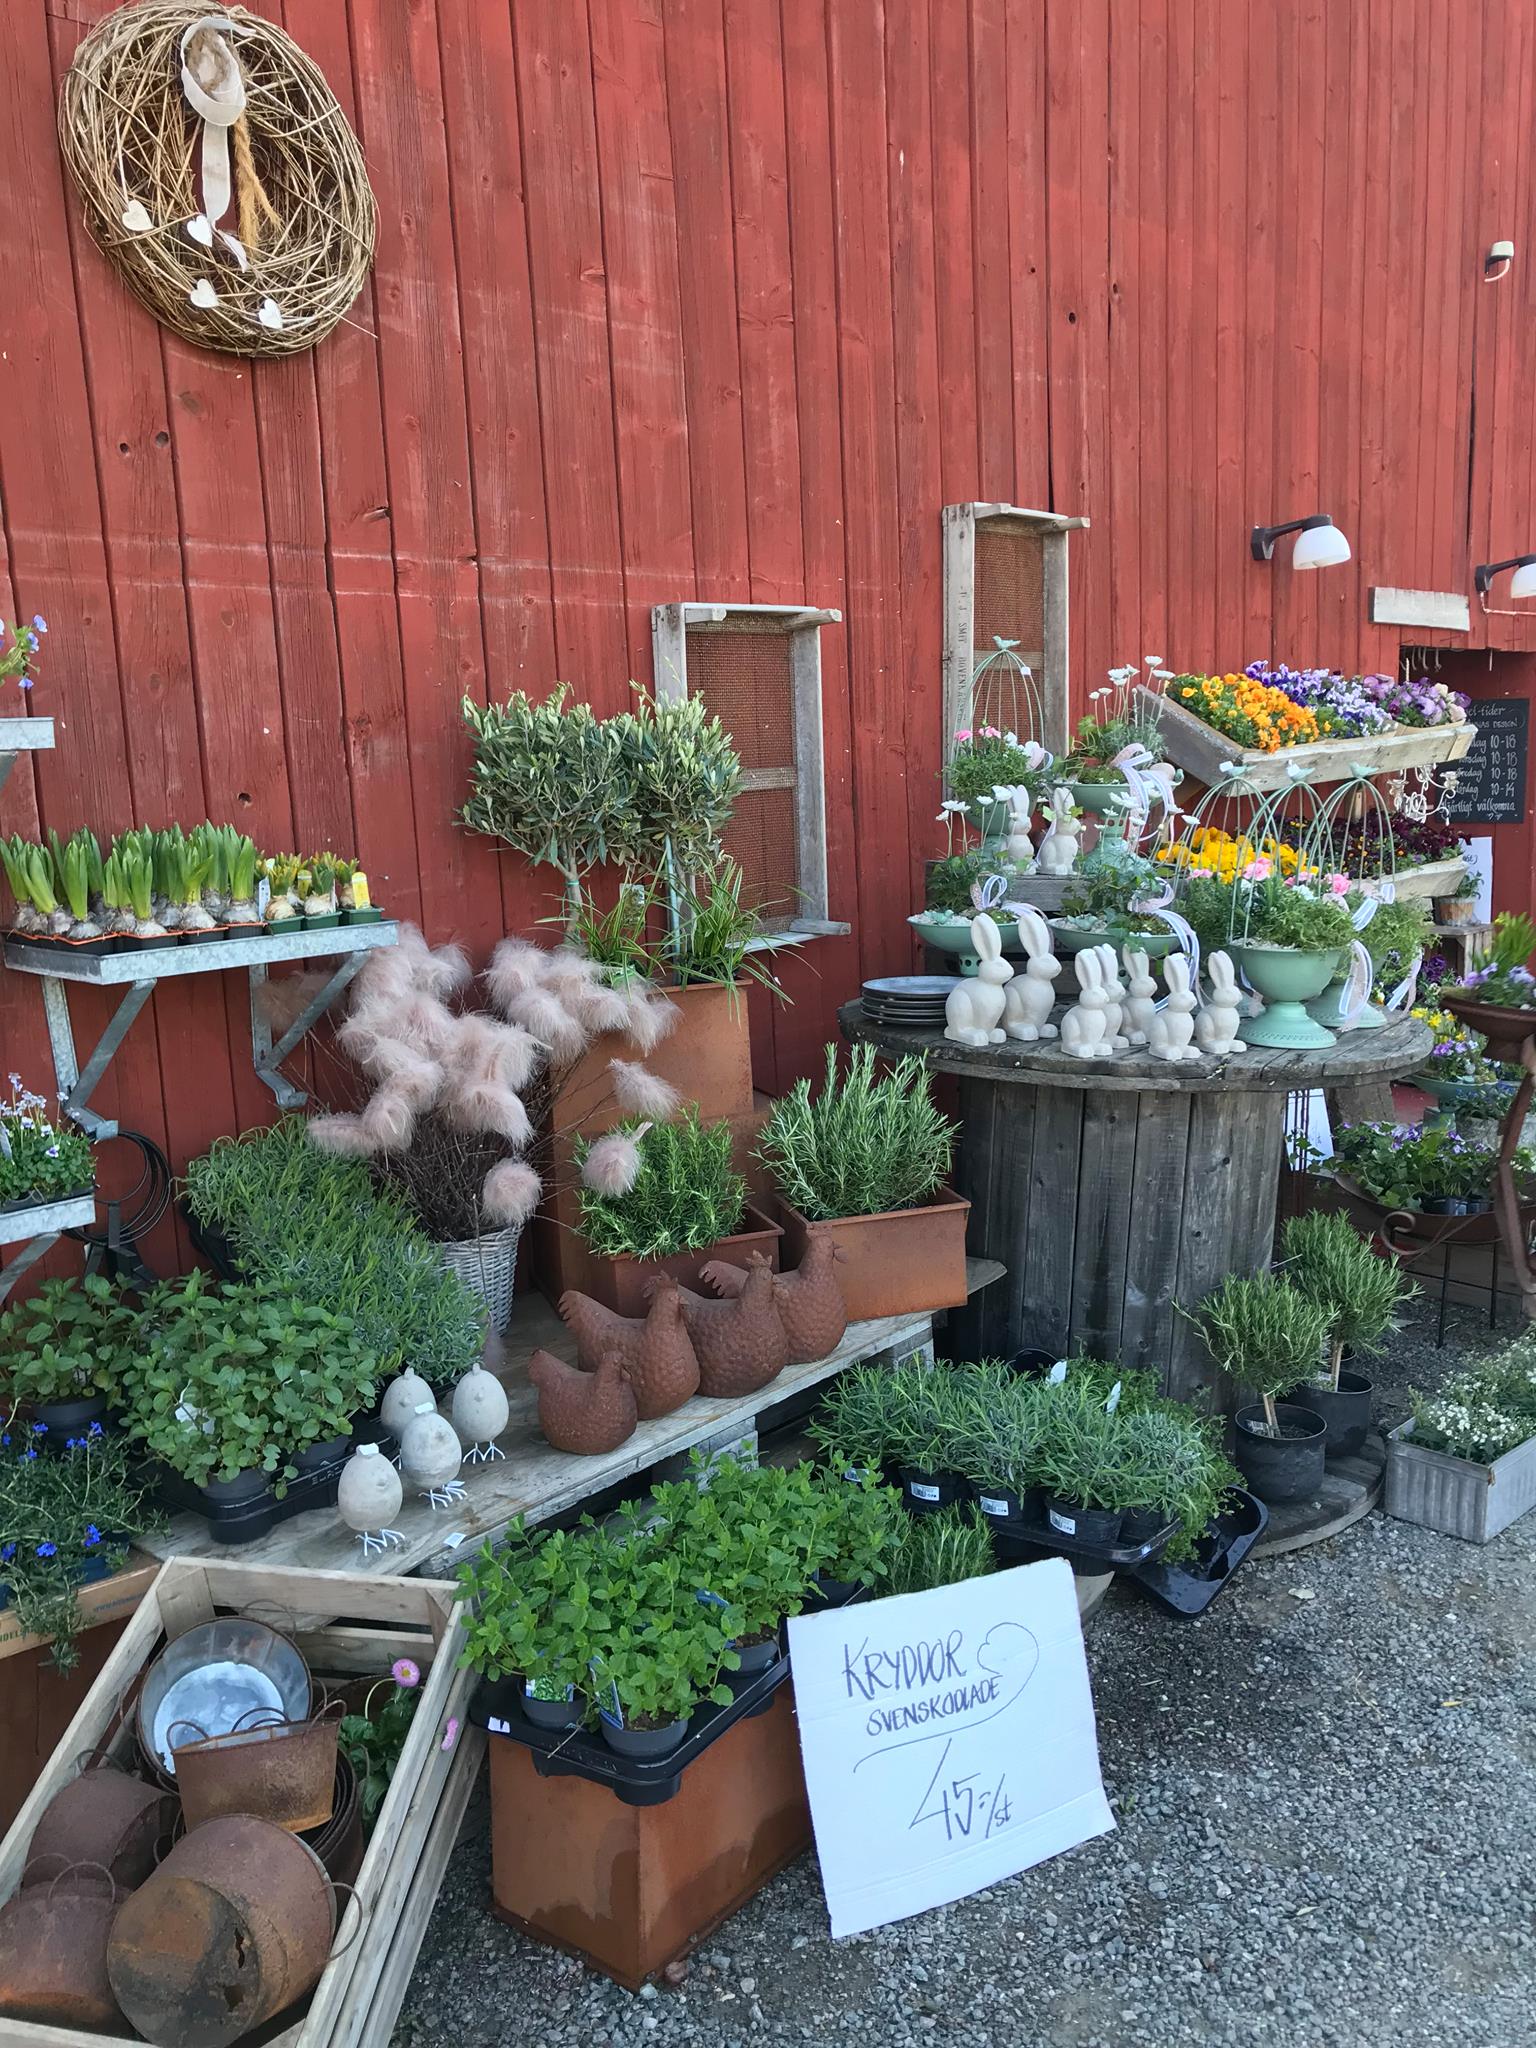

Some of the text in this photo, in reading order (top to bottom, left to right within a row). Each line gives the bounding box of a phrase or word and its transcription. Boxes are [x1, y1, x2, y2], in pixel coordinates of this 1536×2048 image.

[1490, 733, 1517, 750] 10-18
[1490, 751, 1518, 767] 10-18
[1490, 767, 1518, 781] 10-18
[1490, 782, 1515, 797] 10-14
[841, 1629, 968, 1701] KRYDDOR
[866, 1675, 1003, 1736] SVENSKODLADE
